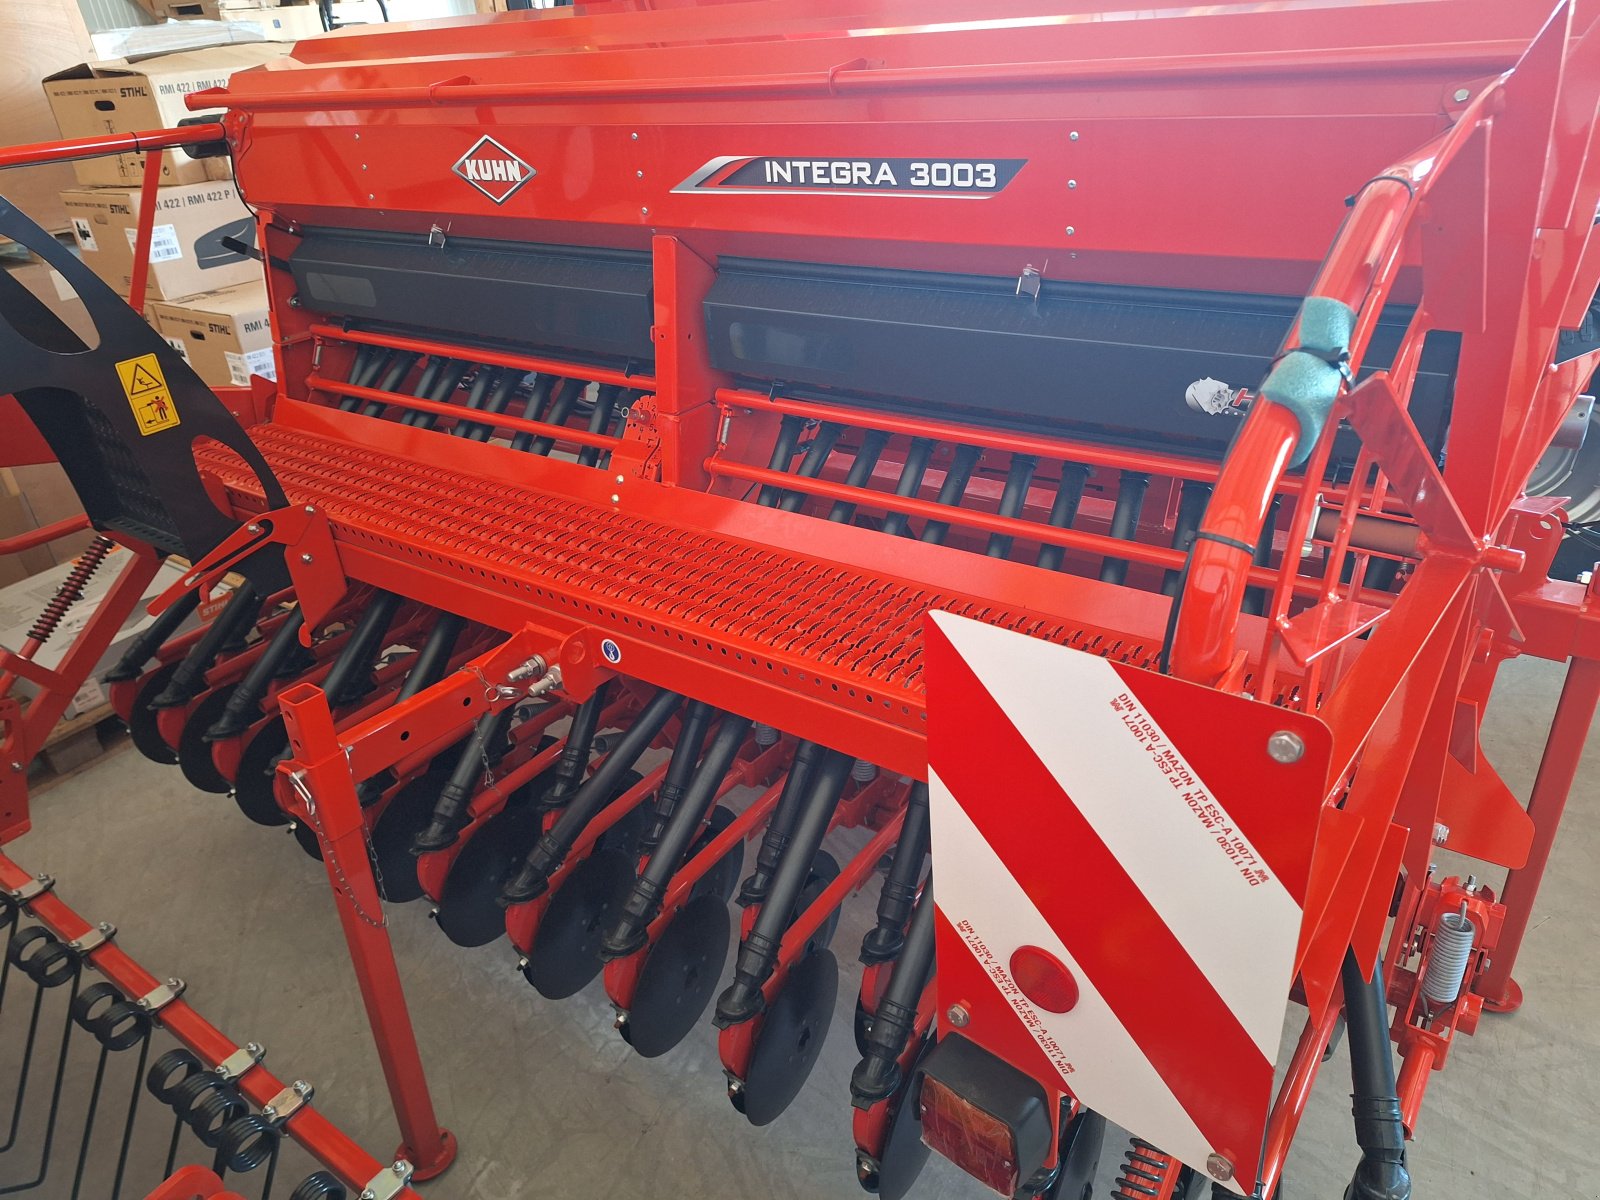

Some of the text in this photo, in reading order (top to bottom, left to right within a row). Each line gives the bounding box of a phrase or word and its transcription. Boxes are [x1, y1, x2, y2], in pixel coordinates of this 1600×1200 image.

[120, 86, 147, 98] STIHL
[160, 84, 175, 94] RMI
[177, 82, 190, 92] 422
[197, 80, 211, 90] RMI
[464, 160, 522, 182] KUHN
[764, 160, 996, 188] INTEGRA 3003
[110, 204, 130, 214] STIHL
[164, 198, 180, 208] 422
[187, 196, 205, 206] RMI
[206, 191, 224, 201] 422
[224, 190, 230, 199] P
[208, 323, 231, 335] STIHL
[244, 320, 262, 333] RMI
[1122, 715, 1146, 743] 10071
[1146, 744, 1172, 774] ESC-A
[1118, 693, 1136, 712] DIN
[1134, 713, 1160, 742] 11030
[1162, 750, 1195, 786] MAZON
[1194, 788, 1208, 802] TP
[1205, 804, 1232, 835] ESC-A
[1230, 837, 1257, 865] 10071
[1169, 777, 1183, 789] TP
[1182, 793, 1214, 828] MAZON
[1217, 836, 1243, 866] 11030
[1240, 868, 1260, 886] DIN
[966, 936, 984, 958] 10071
[984, 960, 1004, 983] ESC-A
[962, 920, 975, 934] DIN
[974, 936, 993, 959] 11030
[995, 966, 1019, 994] MAZON
[1020, 998, 1029, 1008] TP
[1028, 1010, 1048, 1035] ESC-A
[1047, 1036, 1066, 1059] 10071
[1002, 986, 1011, 995] TP
[1012, 999, 1036, 1027] MAZON
[1038, 1035, 1057, 1058] 11030
[1055, 1060, 1070, 1074] DIN
